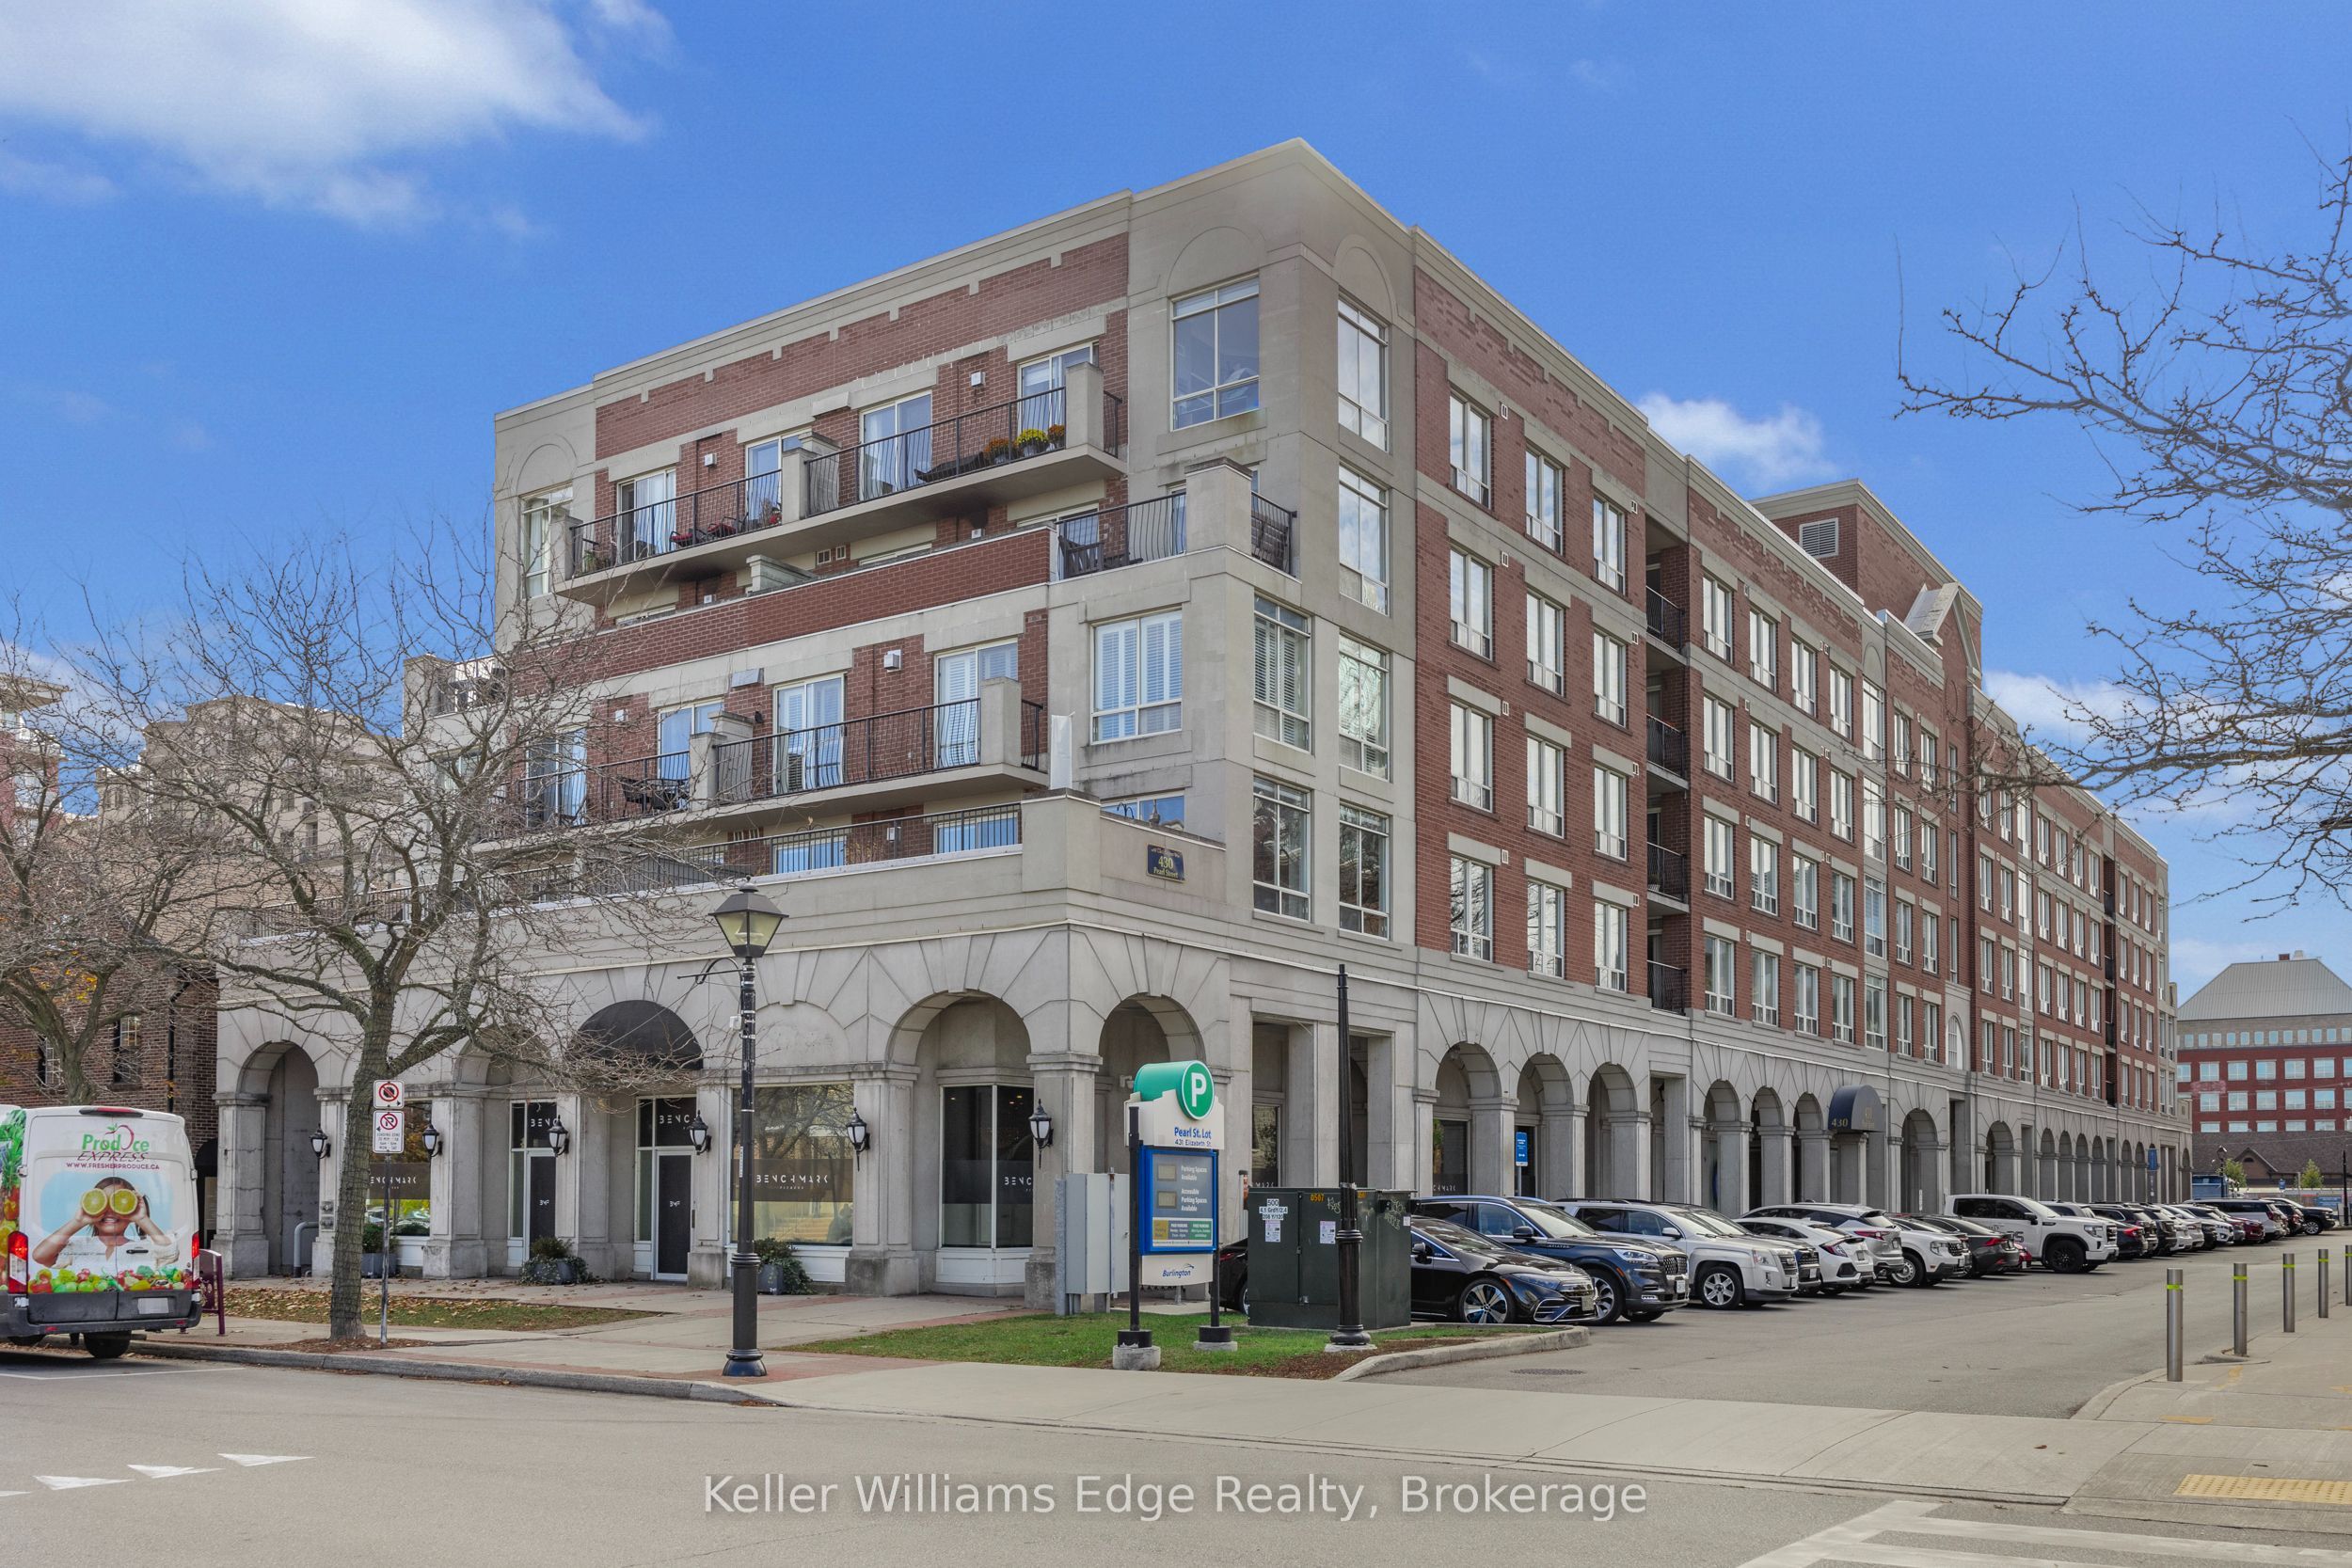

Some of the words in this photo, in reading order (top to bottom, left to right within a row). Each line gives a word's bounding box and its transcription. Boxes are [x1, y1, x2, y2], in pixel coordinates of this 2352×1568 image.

[1158, 856, 1174, 869] 430
[1191, 1072, 1207, 1107] P
[531, 1118, 558, 1128] BENC
[660, 1115, 691, 1124] BENC
[1831, 1117, 1849, 1127] 430
[1174, 1126, 1192, 1137] Pearl
[1193, 1128, 1201, 1138] St.
[1201, 1129, 1212, 1139] Lot
[82, 1128, 150, 1151] Produce
[77, 1150, 149, 1163] EXPRESS
[66, 1162, 160, 1170] WWW.FRESHERPRODUCE.CA
[1181, 1165, 1195, 1174] Parking
[370, 1176, 417, 1184] ENCHMARK
[755, 1174, 828, 1183] BENCHMARK
[1004, 1177, 1032, 1185] BENC
[1181, 1196, 1195, 1205] Parking
[1162, 1270, 1191, 1279] Burlington
